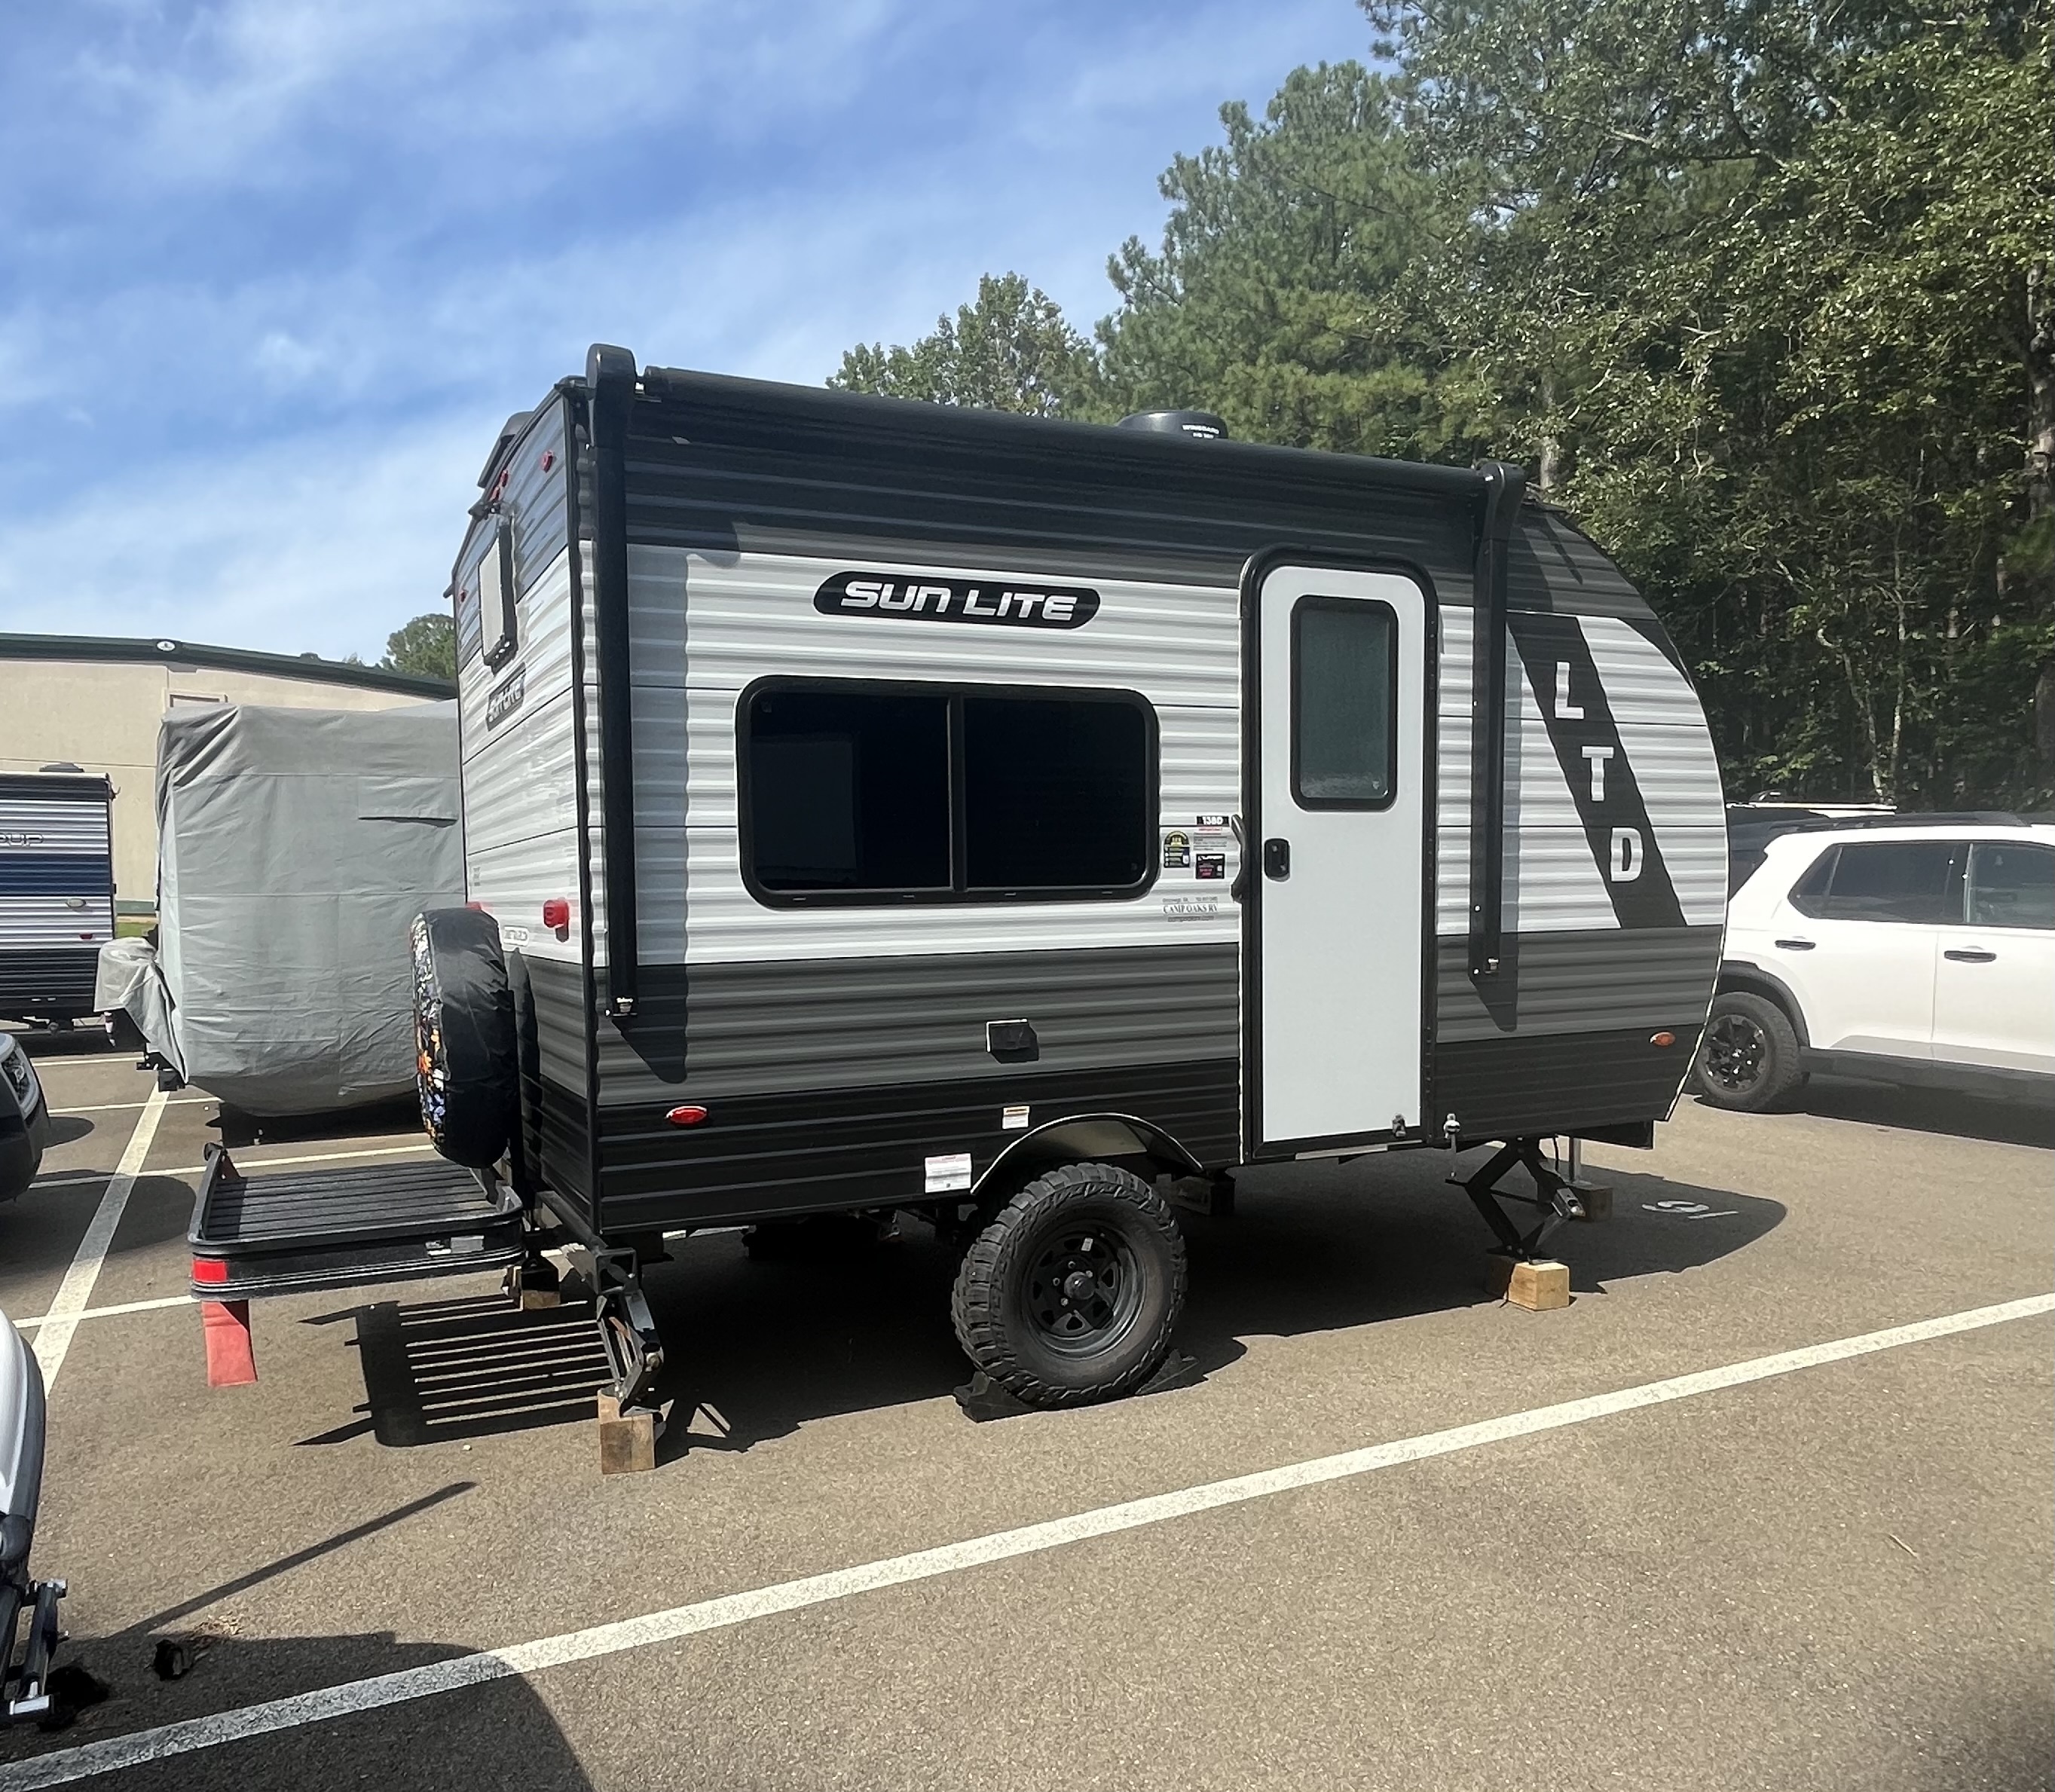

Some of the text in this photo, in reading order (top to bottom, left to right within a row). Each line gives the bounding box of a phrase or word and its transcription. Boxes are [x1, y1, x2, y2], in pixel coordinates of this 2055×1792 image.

[840, 579, 1078, 620] SUN LITE
[1555, 661, 1644, 882] LTD
